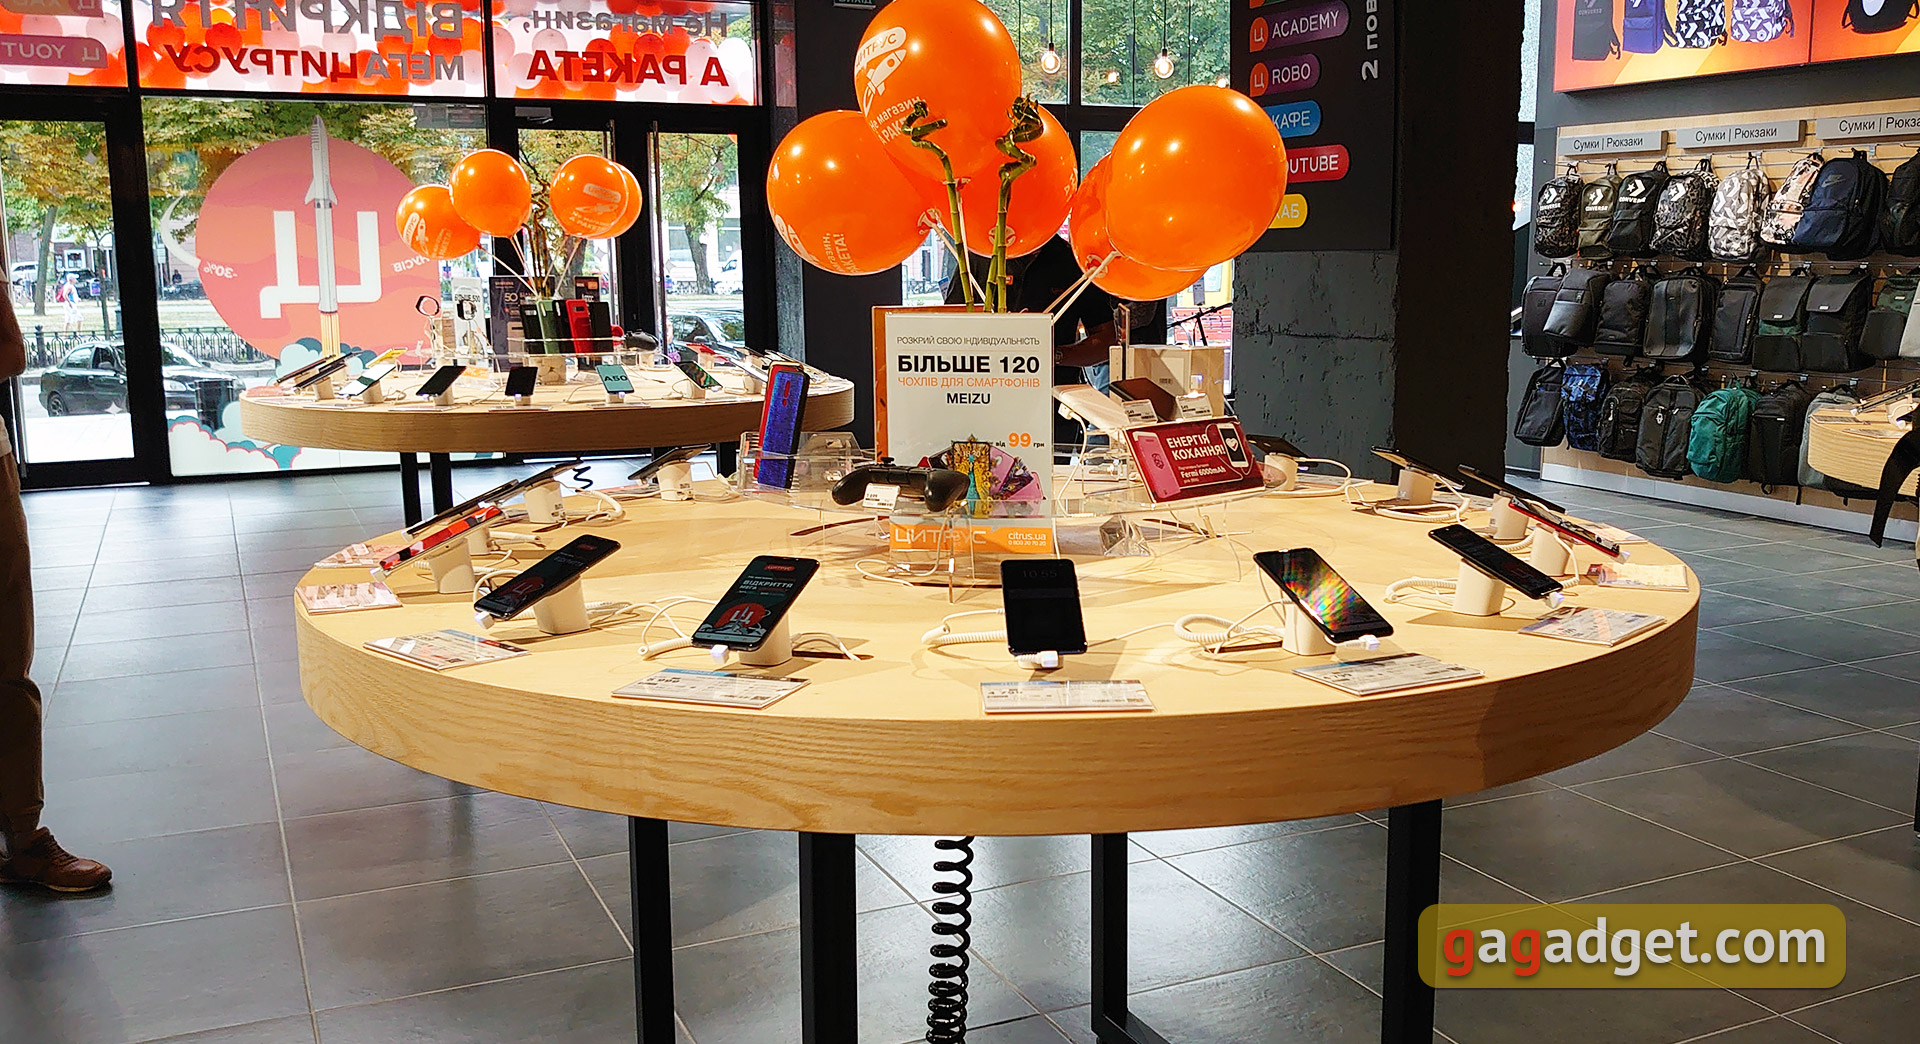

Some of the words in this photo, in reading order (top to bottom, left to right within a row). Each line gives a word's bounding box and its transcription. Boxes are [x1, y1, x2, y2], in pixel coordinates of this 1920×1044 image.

[1272, 10, 1339, 39] ACADEMY
[1272, 63, 1310, 84] ROBO
[1361, 59, 1379, 81] 2
[1272, 110, 1310, 129] КАФЕ
[1839, 118, 1876, 134] Сумки
[1695, 129, 1726, 143] Сумки
[1734, 125, 1777, 141] Рюкзаки
[1573, 137, 1599, 151] Сумки
[1606, 136, 1643, 150] Рюкзаки
[1287, 155, 1339, 174] UTUBE
[897, 335, 935, 345] РОЗКРИЙ
[936, 337, 962, 345] СВОЮ
[964, 337, 1040, 346] ІНДИВІДУАЛЬНІСТЬ
[898, 355, 990, 373] БІЛЬШЕ
[999, 356, 1040, 373] 120
[898, 377, 938, 387] ЧОХЛІВ
[941, 377, 964, 388] ДЛЯ
[966, 377, 1040, 388] СМАРТФОНІВ
[946, 393, 991, 404] MEIZU
[1008, 432, 1031, 448] 99
[1166, 433, 1211, 449] ЕНЕРГІЯ
[1172, 444, 1226, 461] КОХАННЯ!
[1180, 469, 1199, 479] Fermi
[1008, 531, 1047, 540] citrus.ua
